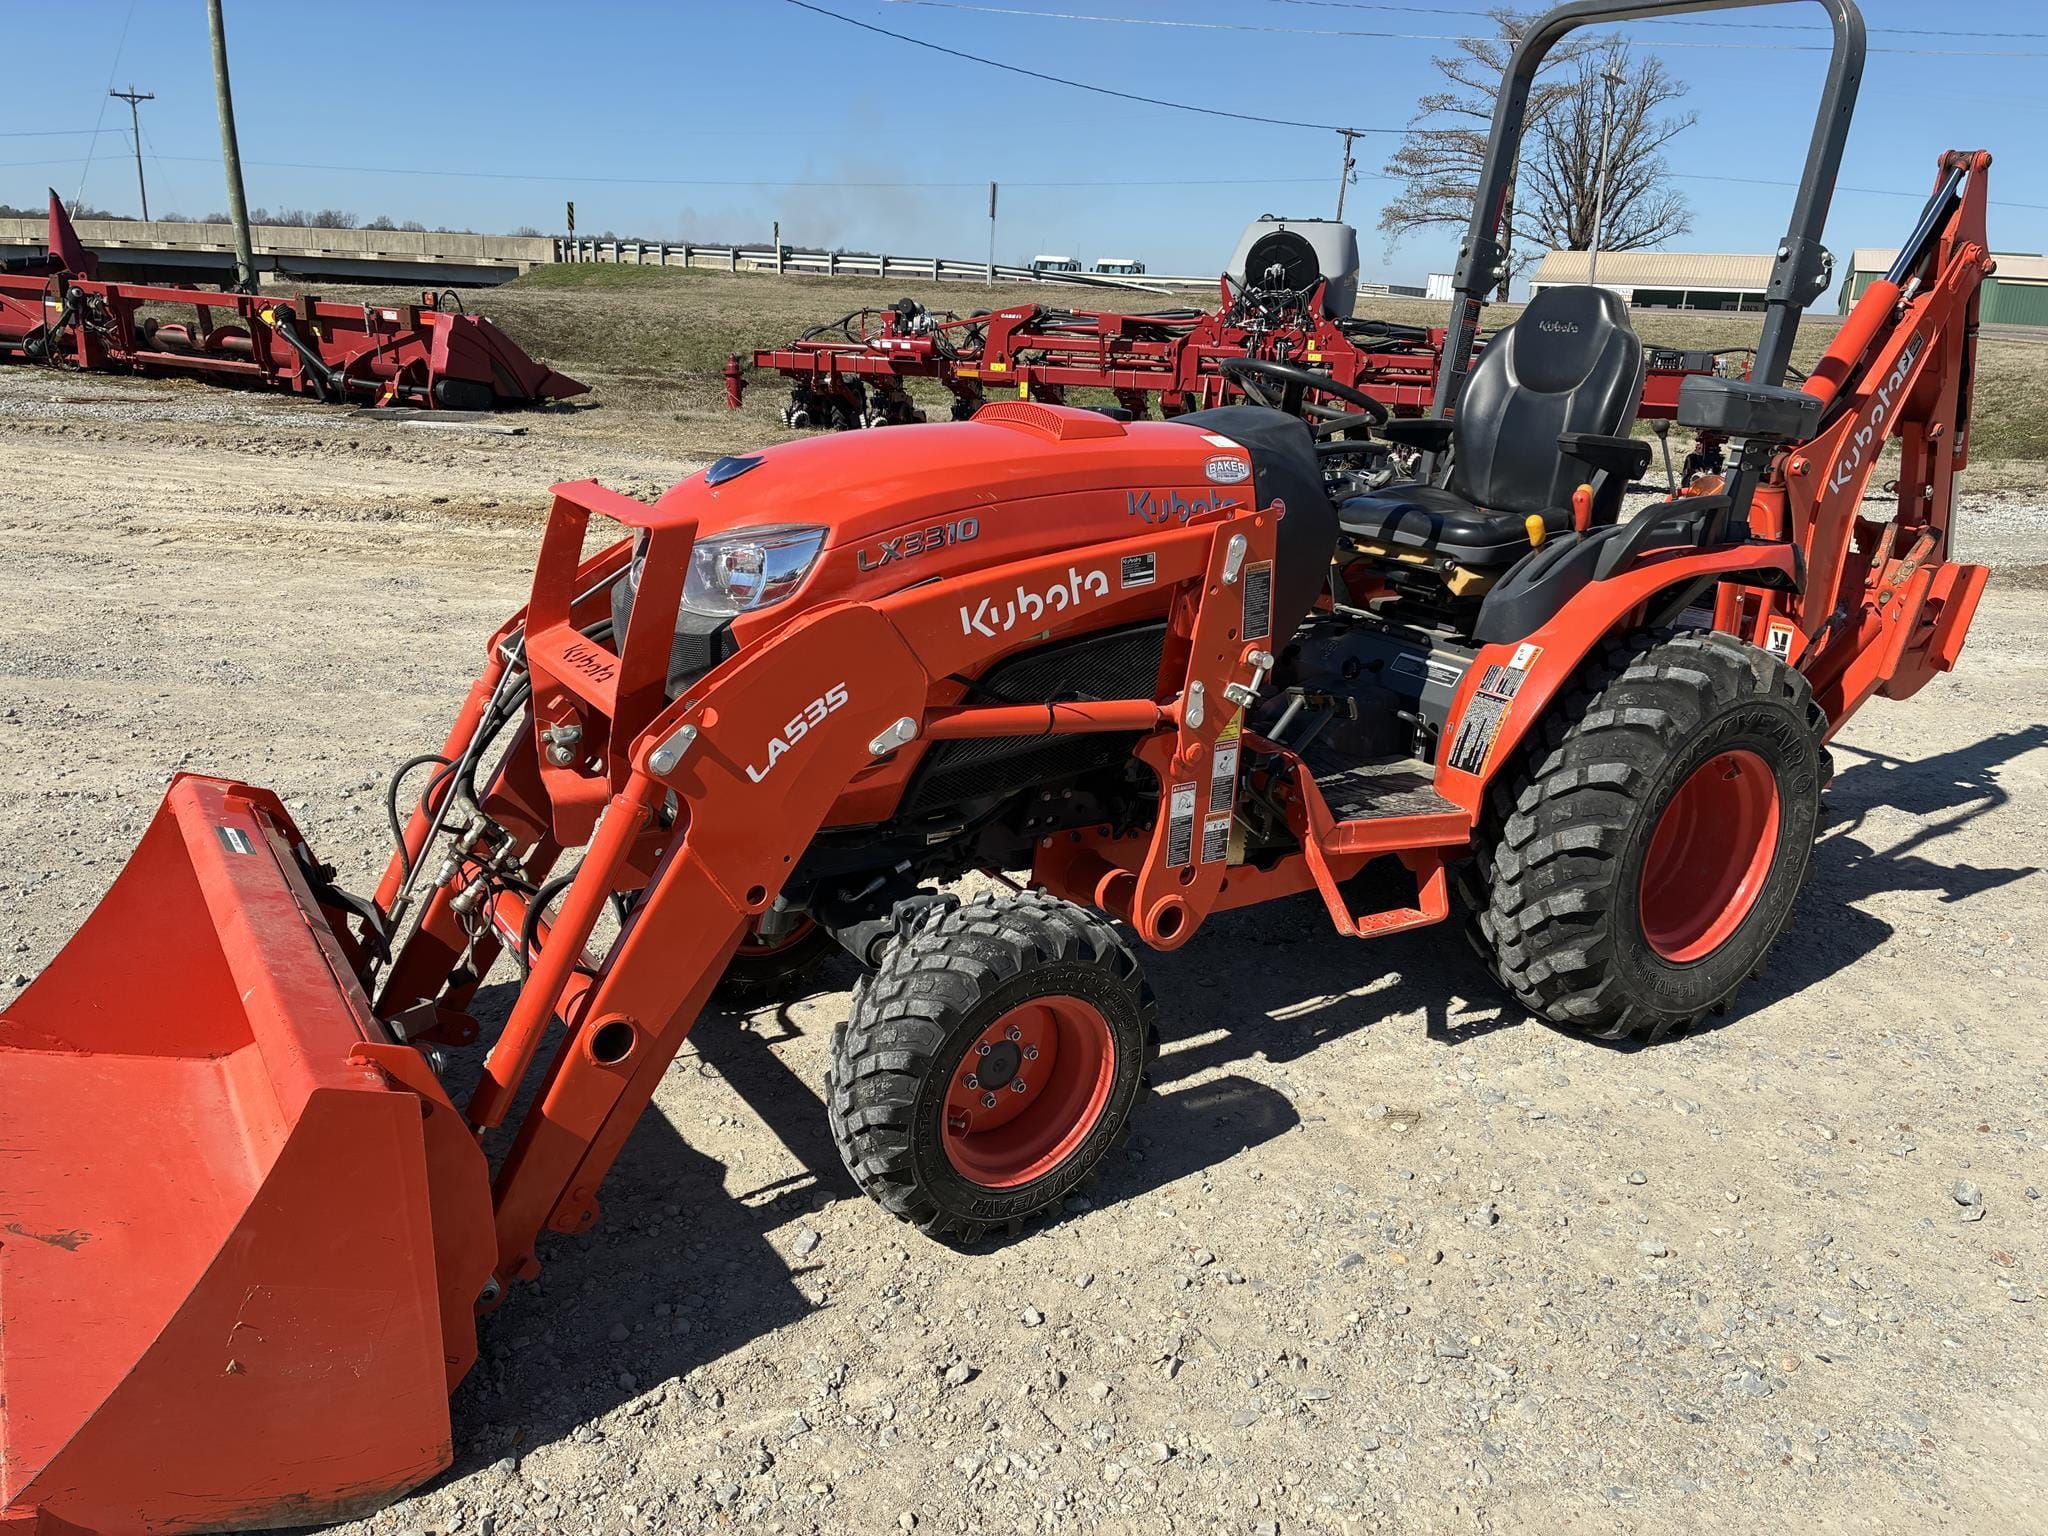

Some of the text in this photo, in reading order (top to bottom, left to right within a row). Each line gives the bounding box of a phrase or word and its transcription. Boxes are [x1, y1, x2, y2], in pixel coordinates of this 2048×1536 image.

[1539, 320, 1579, 333] Kubota
[1829, 370, 1903, 494] Kubota
[1209, 461, 1246, 474] BAKER
[857, 517, 980, 573] LX3310
[960, 567, 1109, 638] Kubota
[563, 643, 615, 683] Kubota
[745, 681, 849, 783] LA535
[969, 1111, 1122, 1217] GOODYEAR
